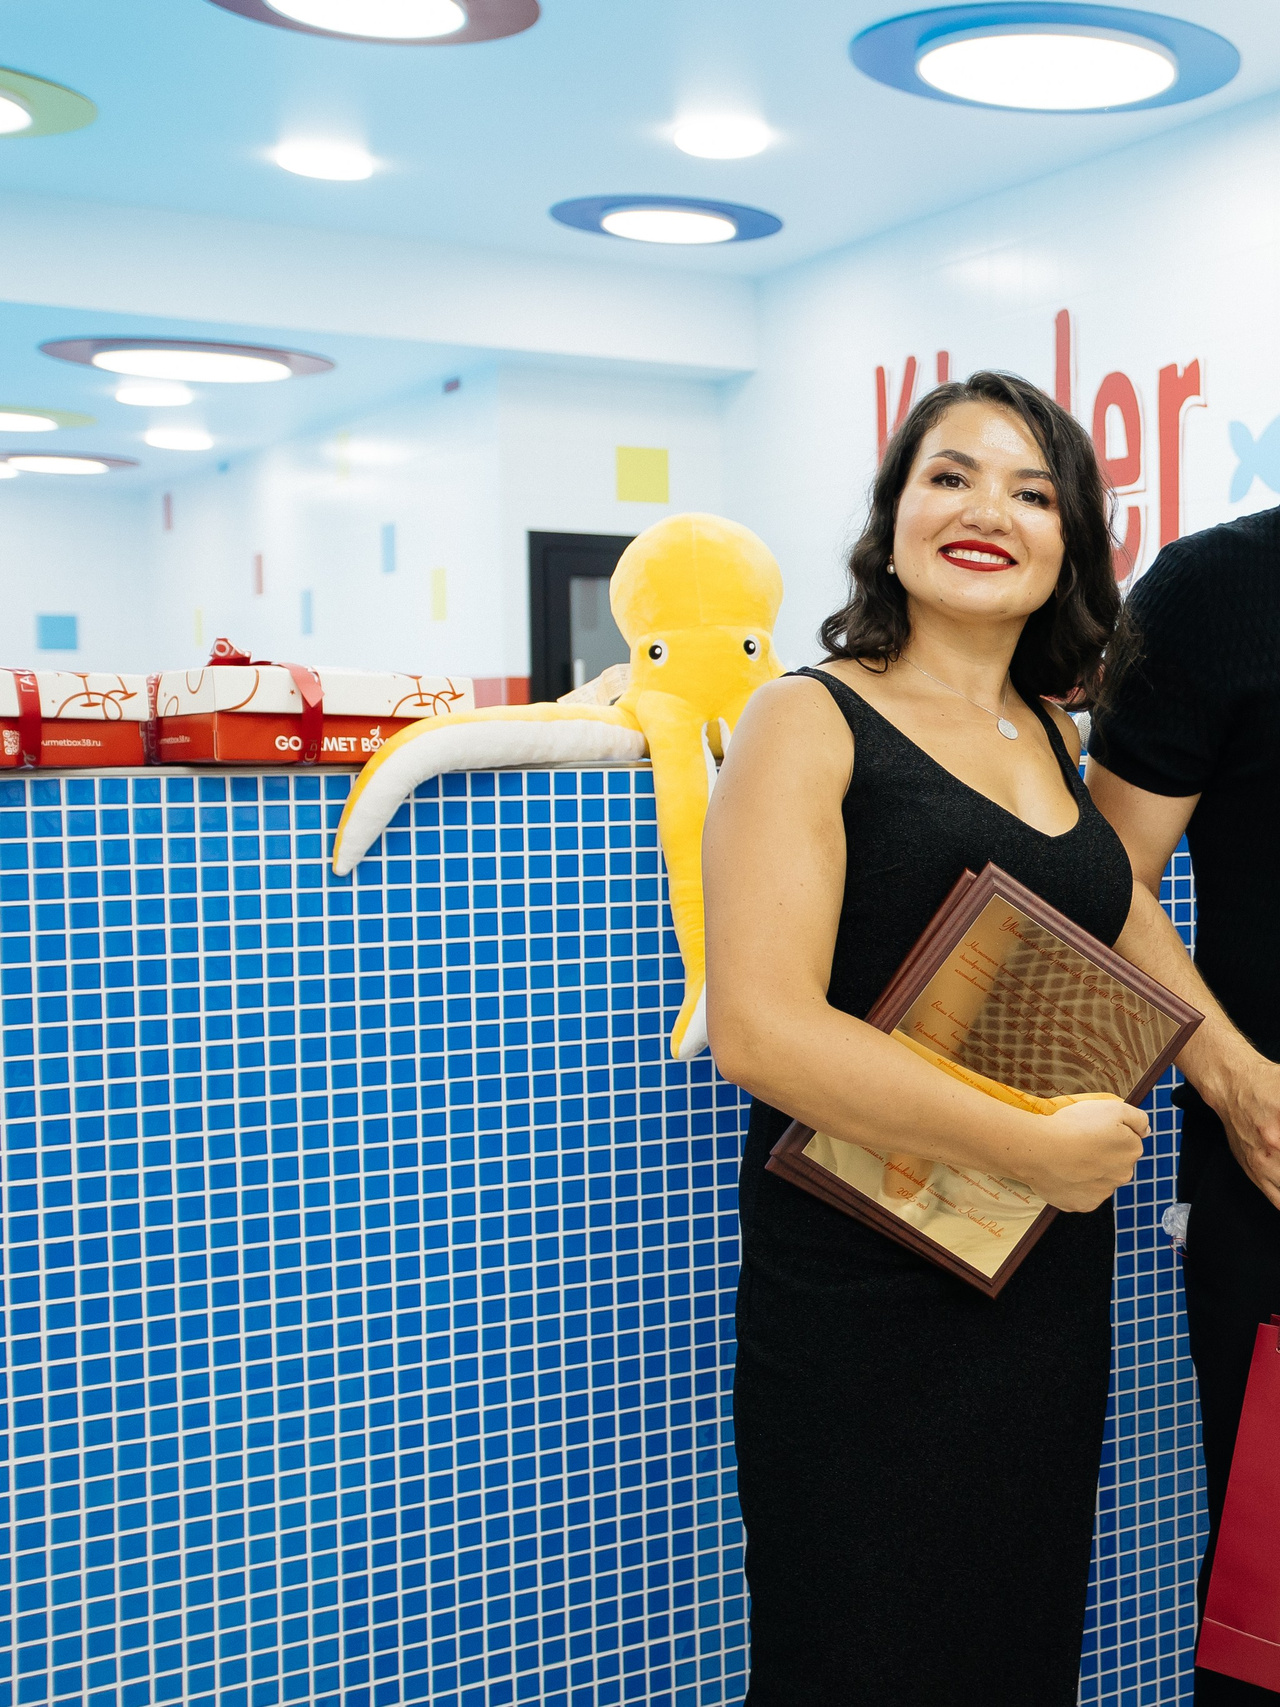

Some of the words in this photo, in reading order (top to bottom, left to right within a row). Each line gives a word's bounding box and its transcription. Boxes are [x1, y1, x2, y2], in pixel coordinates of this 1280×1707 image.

[275, 735, 357, 752] GOMET
[1000, 915, 1045, 954] Уважаемый
[1083, 977, 1107, 998] Сергей
[885, 1160, 925, 1188] руководство
[927, 1183, 955, 1208] компании
[896, 1186, 917, 1203] 2025
